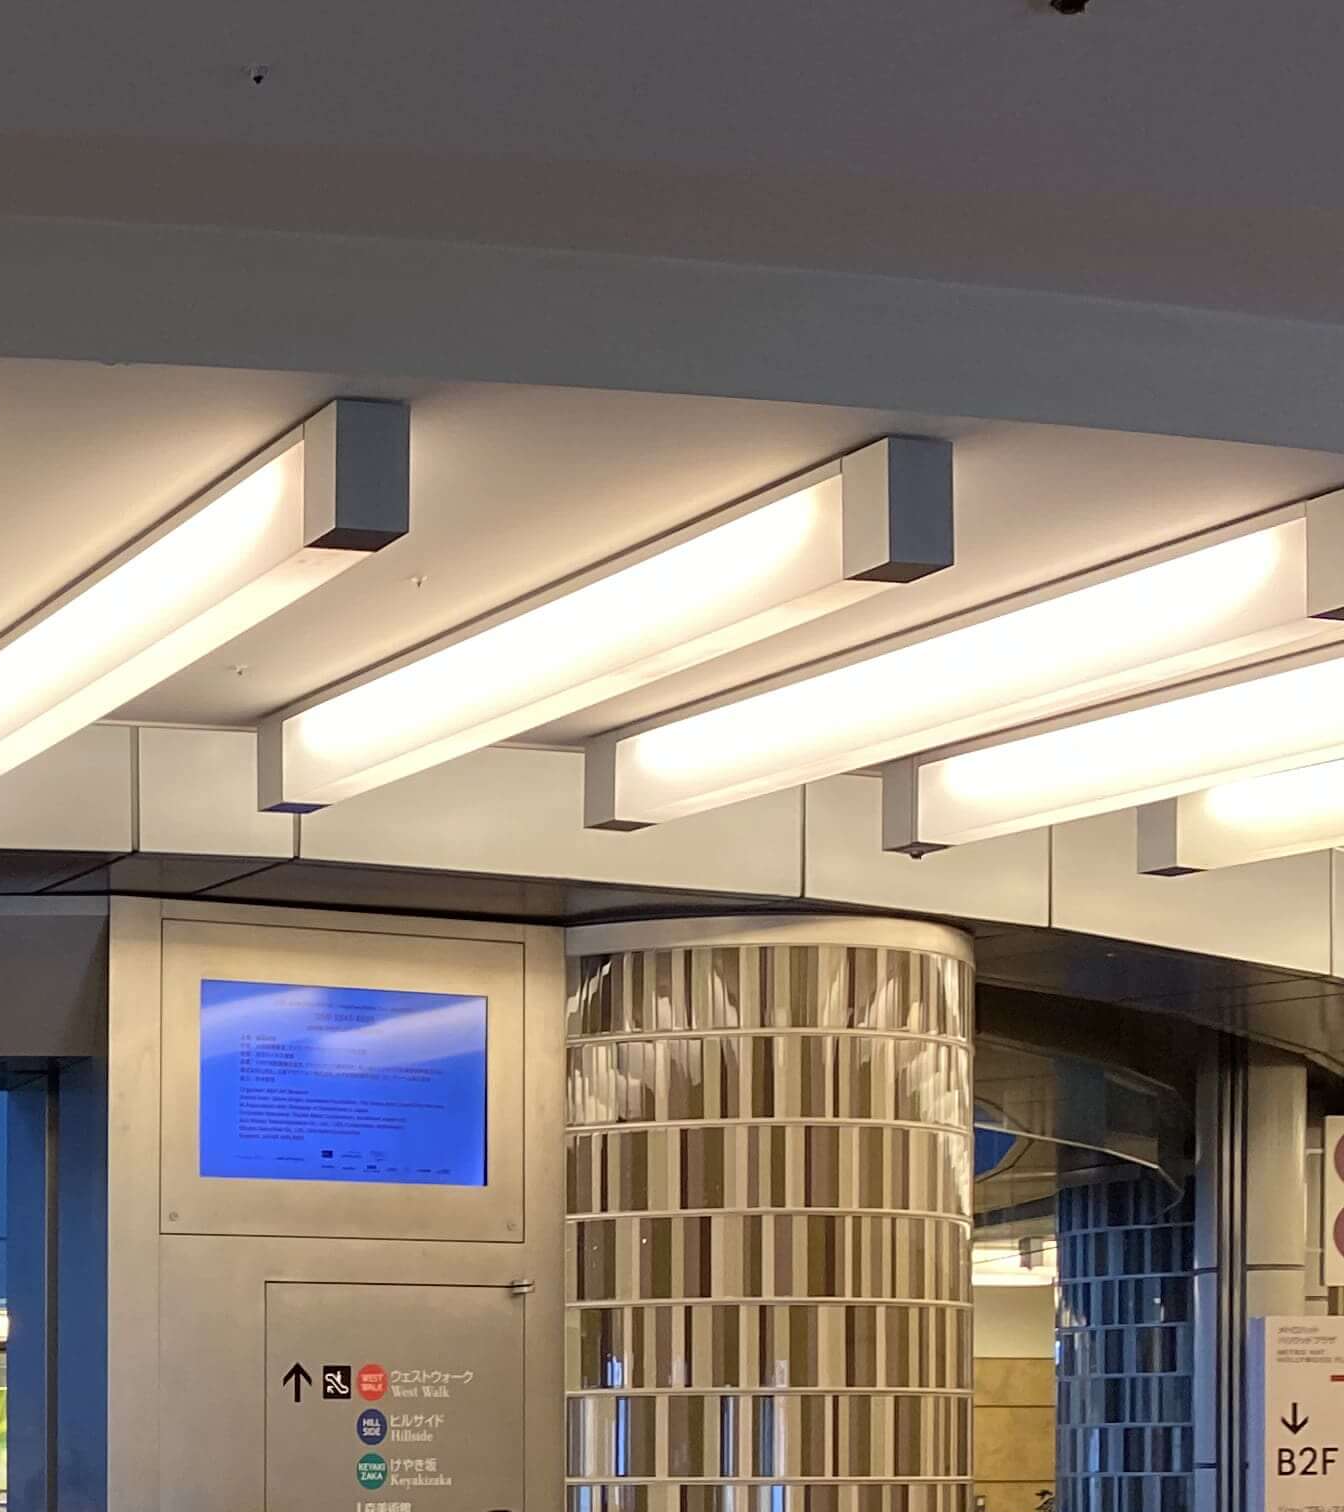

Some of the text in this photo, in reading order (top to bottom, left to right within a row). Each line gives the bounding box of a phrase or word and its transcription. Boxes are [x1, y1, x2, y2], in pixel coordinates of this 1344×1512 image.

[391, 1370, 474, 1384] ウェストウォーク
[391, 1385, 450, 1398] West Walk
[362, 1418, 381, 1427] HILL
[391, 1414, 445, 1428] ヒルサイド
[391, 1429, 433, 1442] Hillside
[358, 1462, 386, 1471] KEYAKI
[390, 1458, 438, 1472] けやき坂
[1277, 1446, 1339, 1476] B2F
[360, 1472, 384, 1481] ZAKA
[391, 1474, 452, 1490] Keyakizaka
